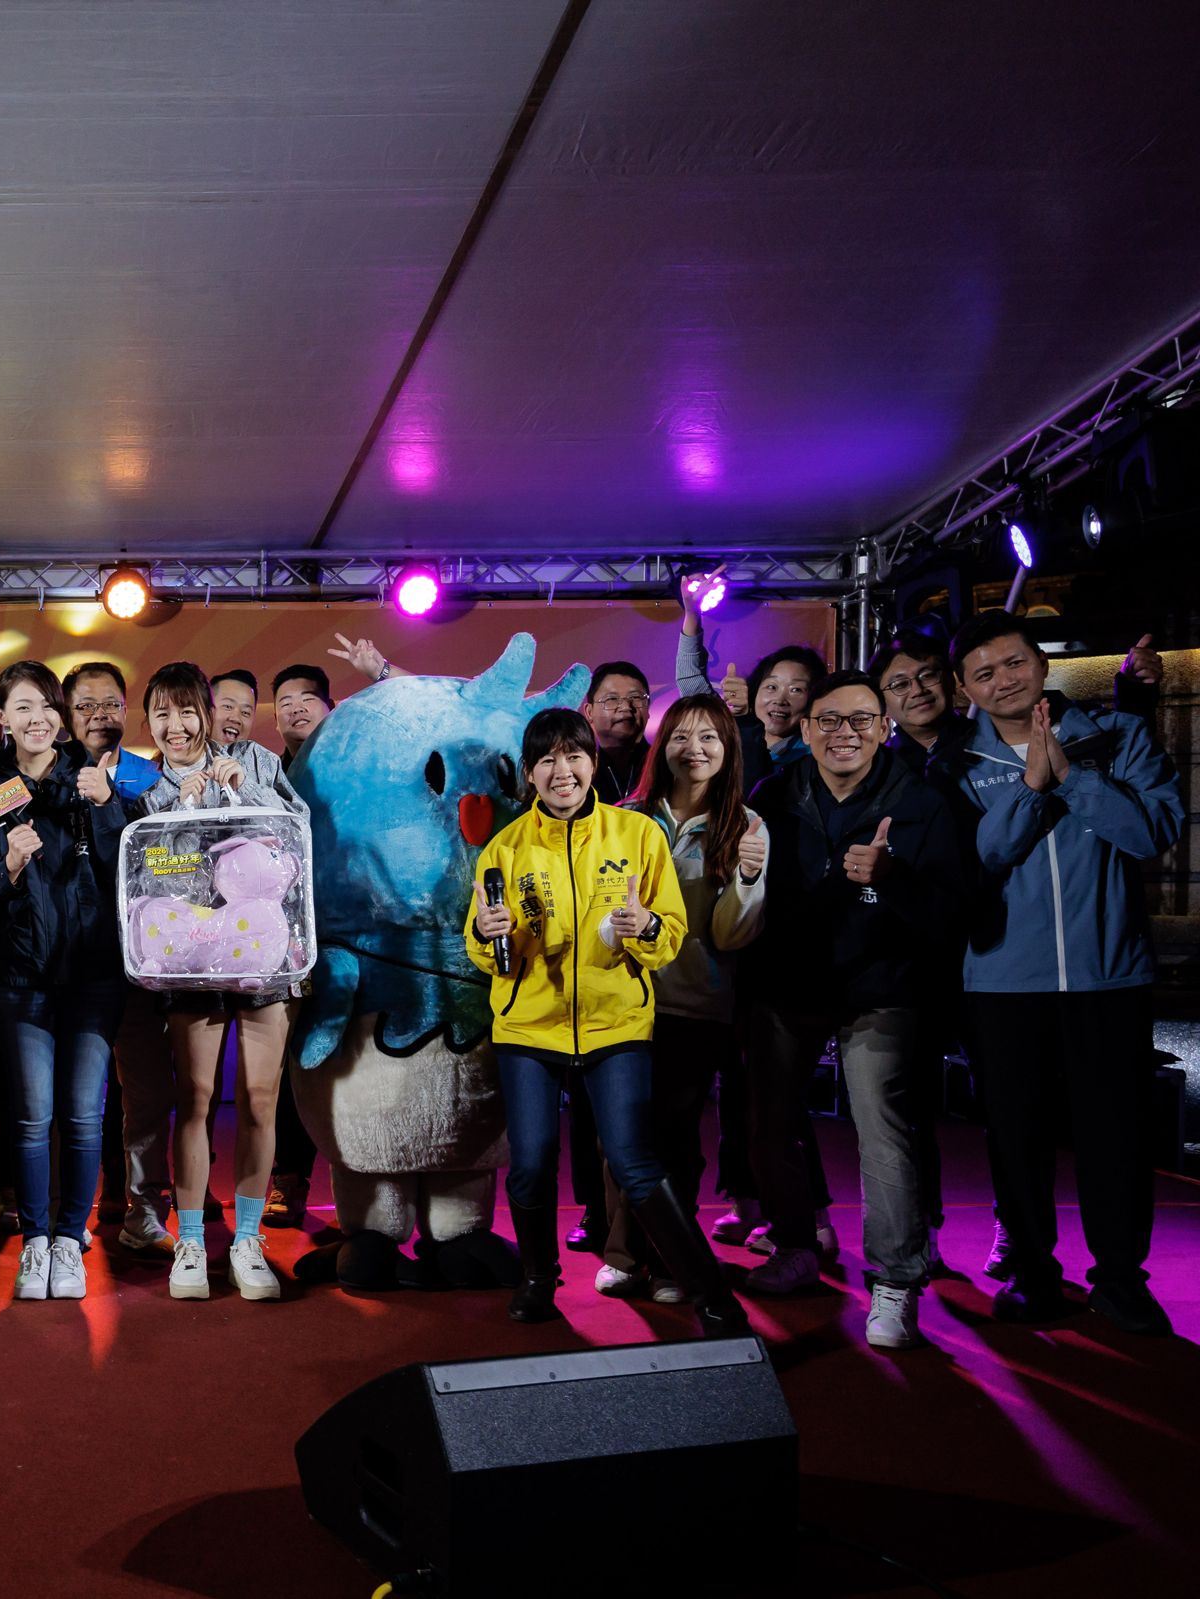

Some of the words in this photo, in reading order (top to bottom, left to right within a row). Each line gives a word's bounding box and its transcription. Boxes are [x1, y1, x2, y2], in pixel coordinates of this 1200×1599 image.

[146, 847, 168, 856] 2026
[146, 853, 201, 868] 新竹過好年
[540, 871, 555, 918] 新竹市議員
